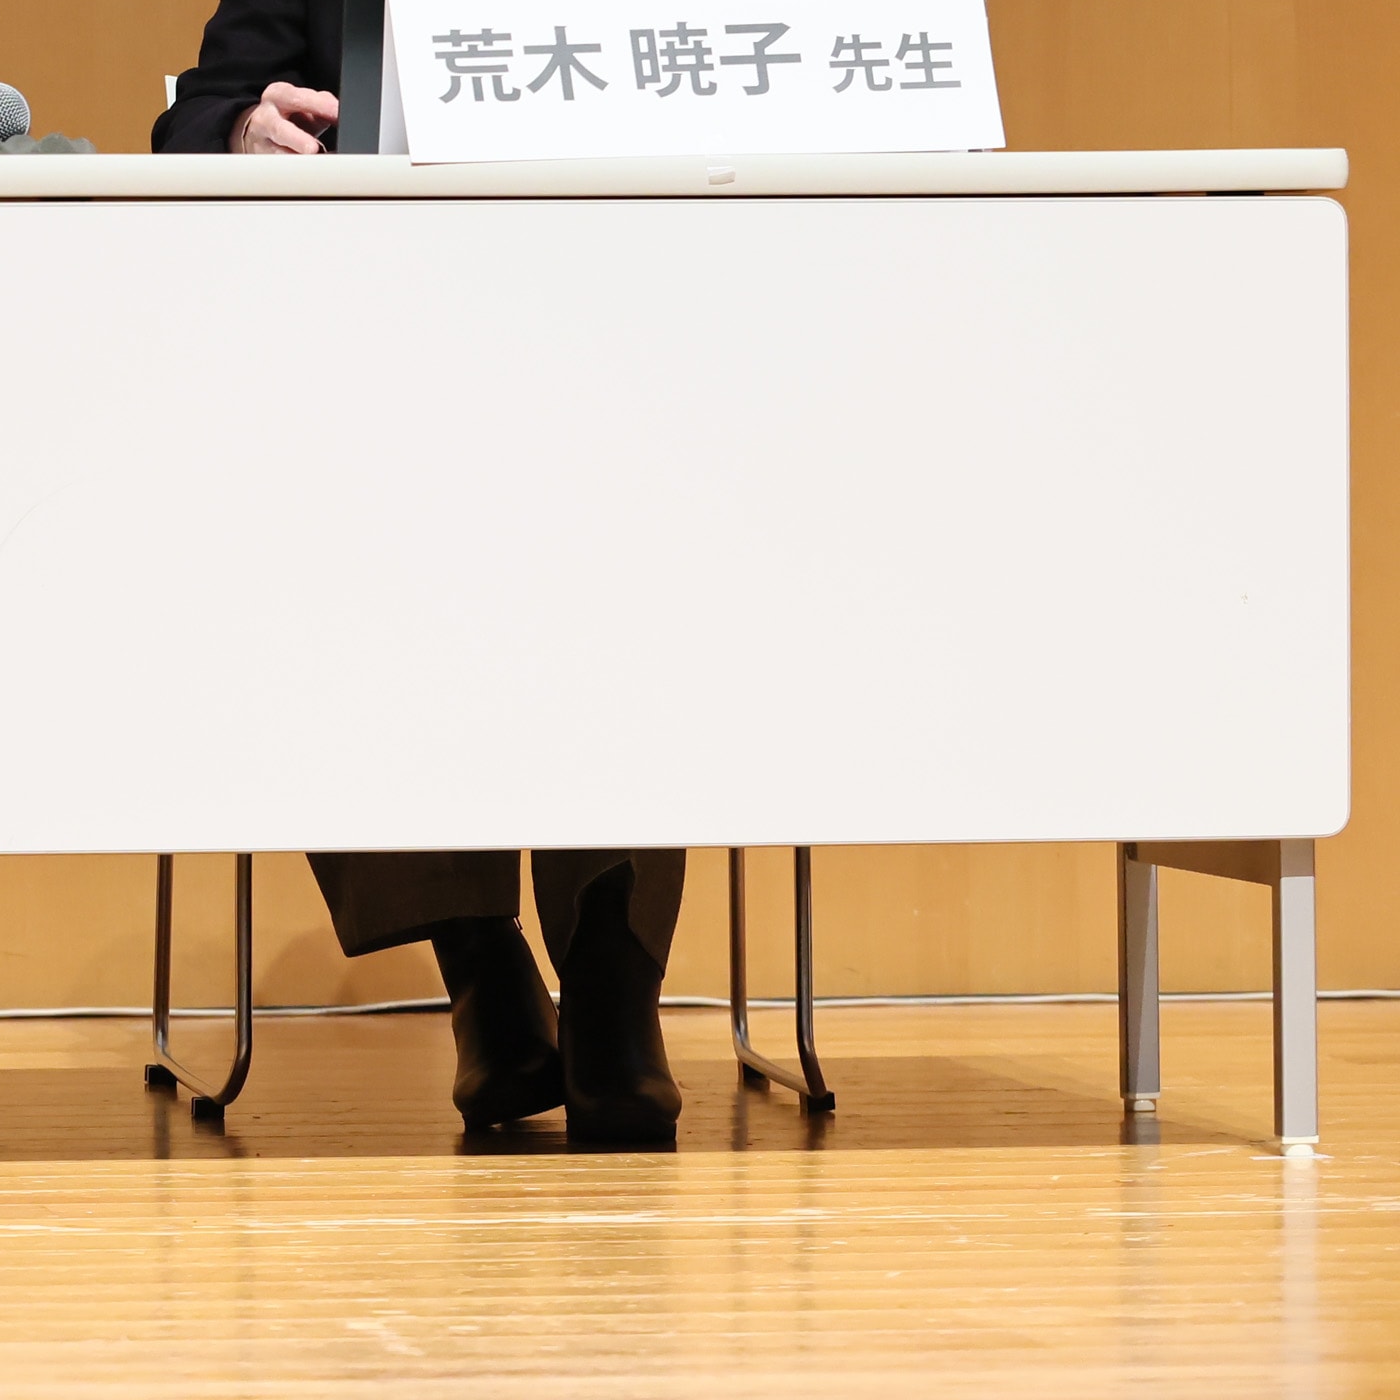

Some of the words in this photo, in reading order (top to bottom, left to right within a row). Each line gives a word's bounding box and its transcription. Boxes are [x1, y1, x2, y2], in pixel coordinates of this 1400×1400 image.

[431, 25, 609, 104] 荒木
[629, 21, 802, 98] 暁子
[828, 31, 962, 94] 先生
